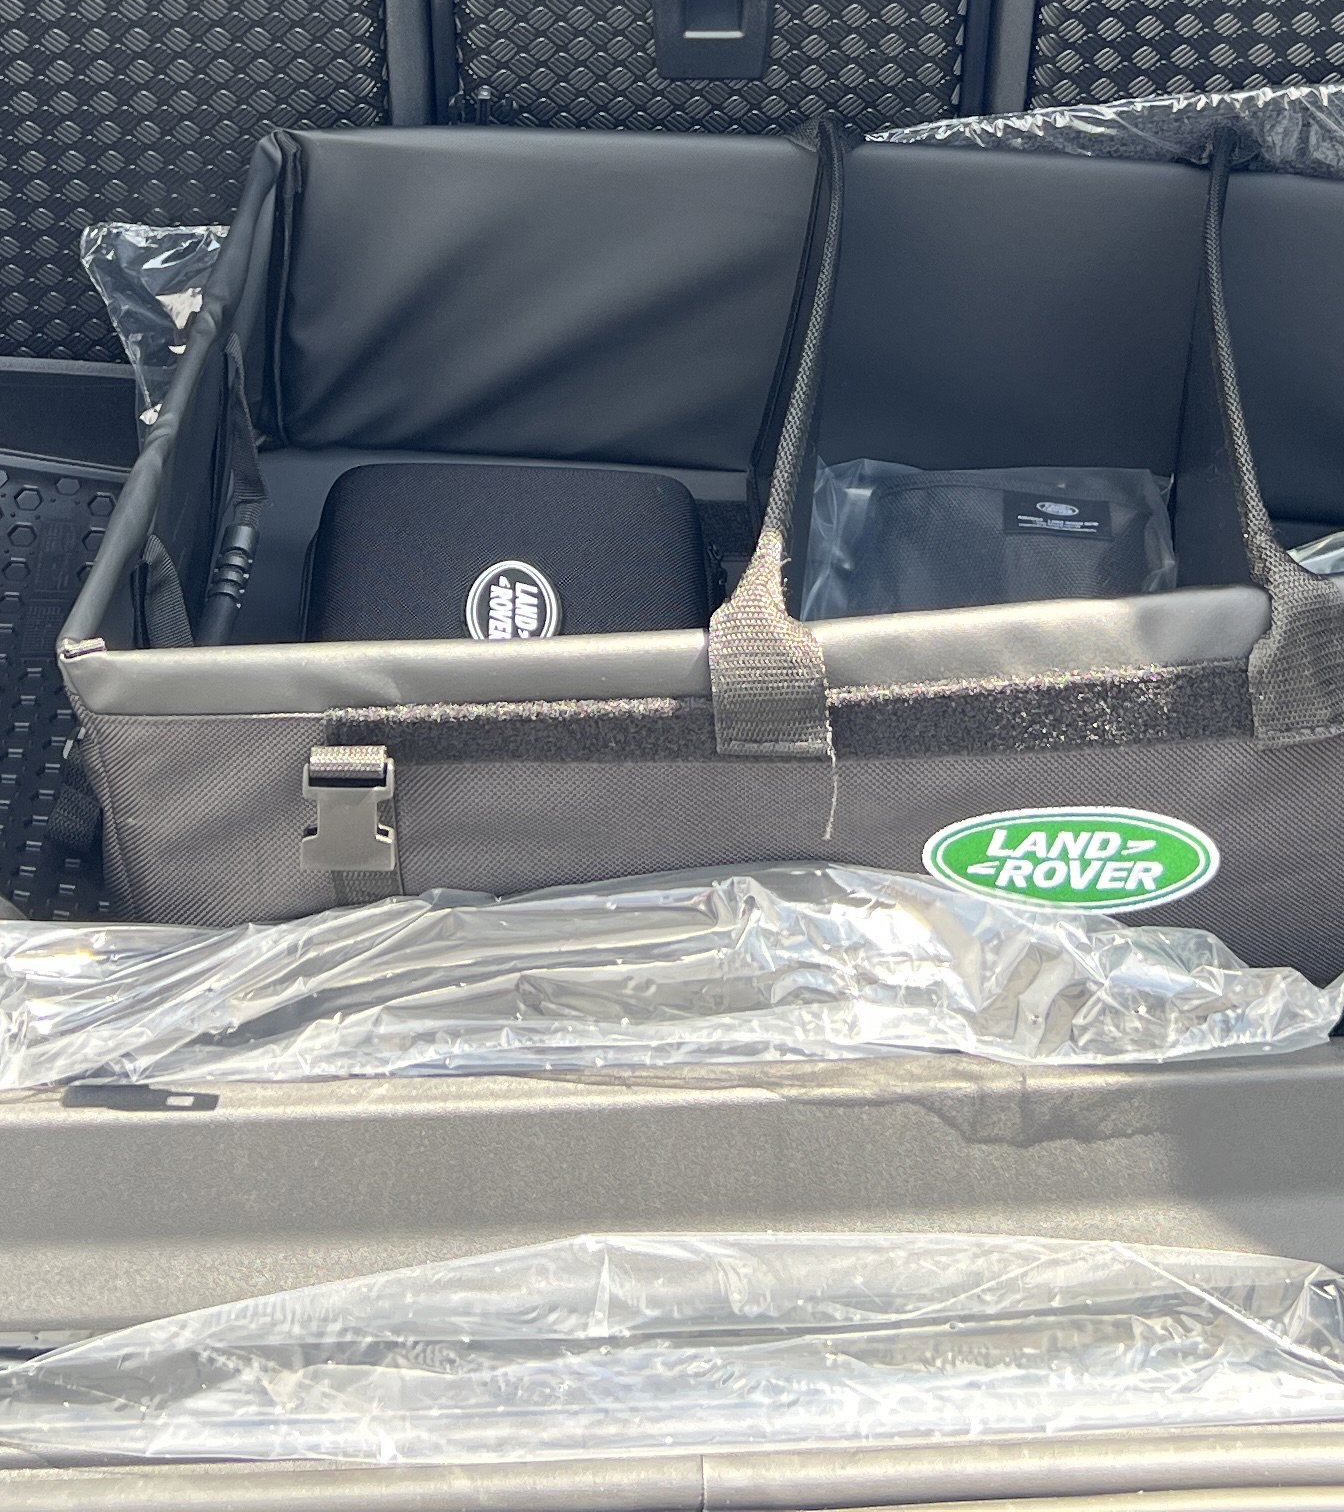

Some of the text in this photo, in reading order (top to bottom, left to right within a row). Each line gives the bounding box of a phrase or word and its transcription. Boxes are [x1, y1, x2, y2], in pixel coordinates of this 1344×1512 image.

[515, 582, 538, 630] LAND
[986, 829, 1123, 859] LAND
[996, 859, 1164, 890] ROVER
